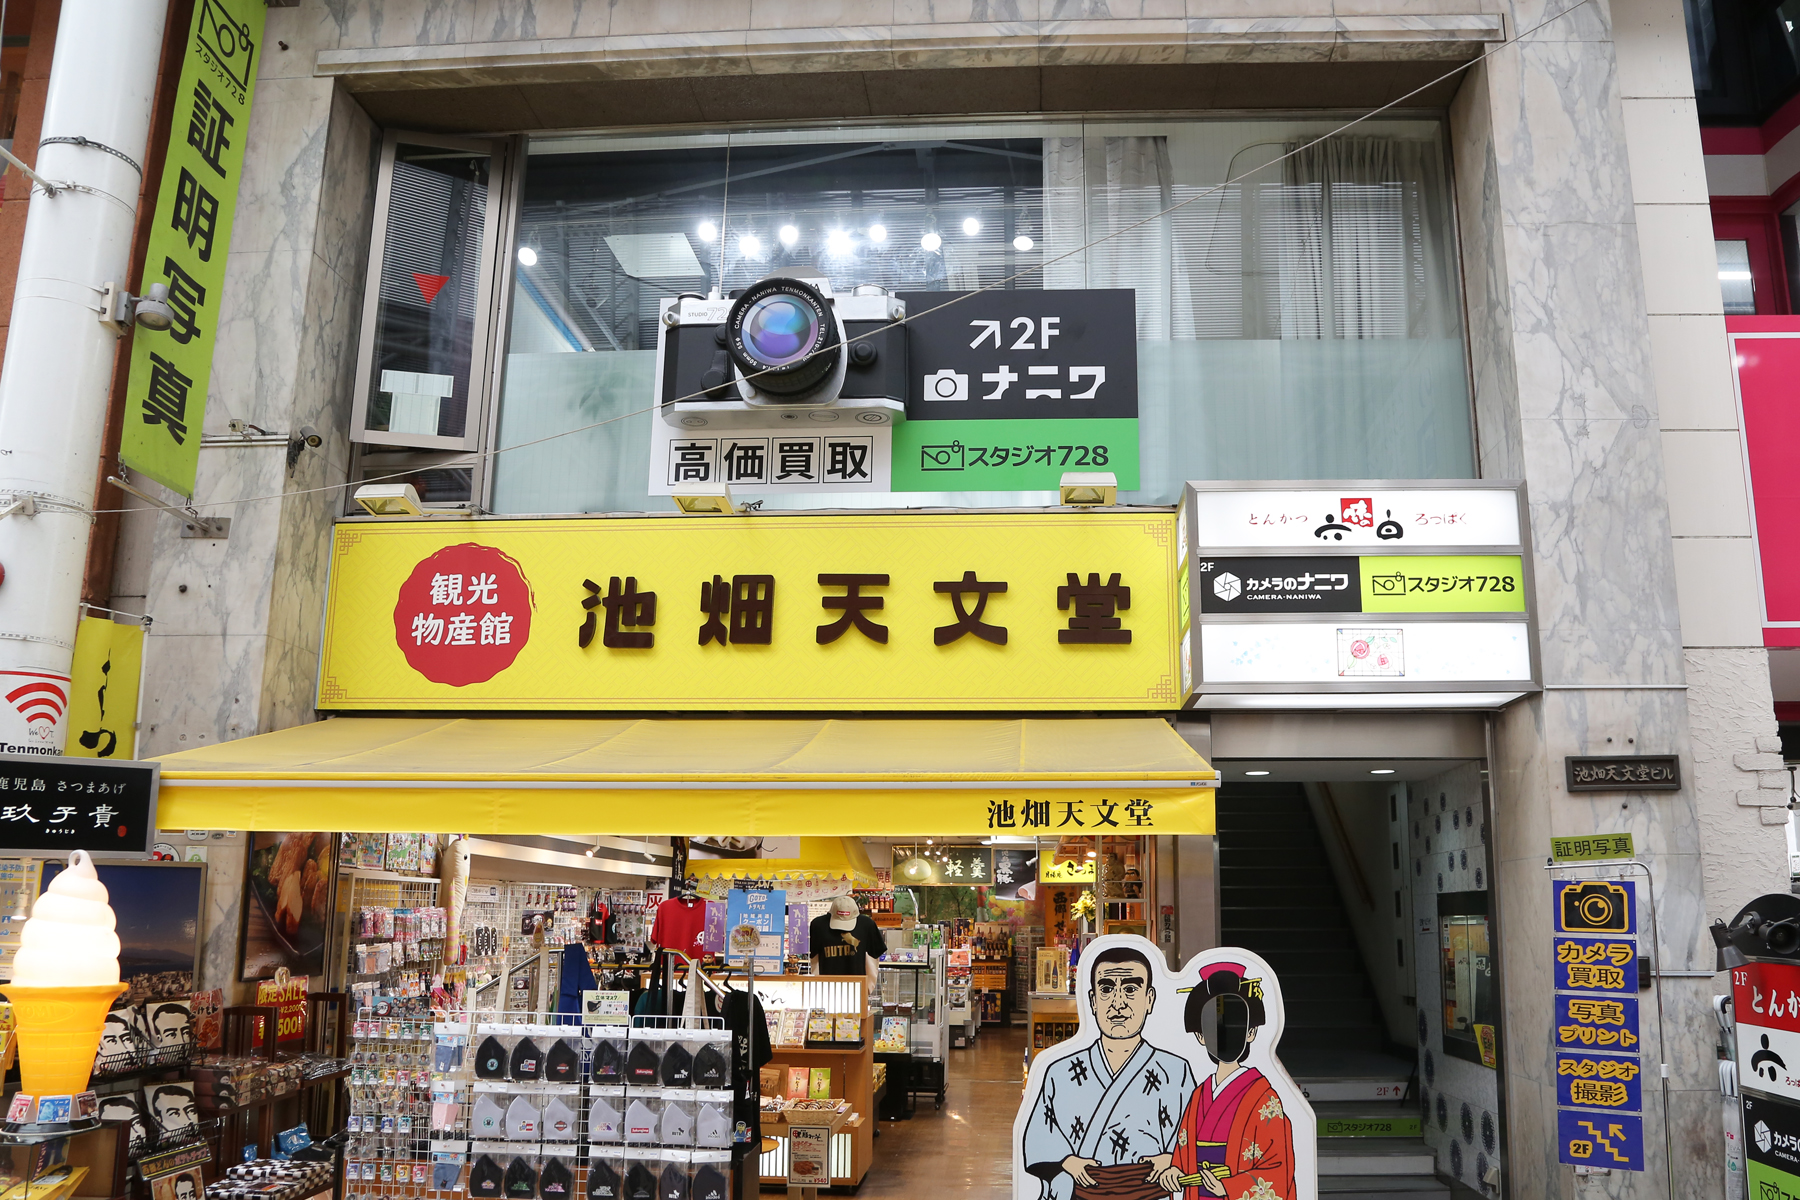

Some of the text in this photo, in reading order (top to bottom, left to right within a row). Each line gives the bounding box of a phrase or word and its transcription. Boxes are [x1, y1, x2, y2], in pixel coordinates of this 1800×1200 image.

[195, 42, 245, 105] スタジオ728
[142, 79, 234, 446] 証明写真
[734, 303, 749, 329] CAMERA
[752, 287, 777, 301] NANIWA
[1010, 316, 1060, 350] 2F
[982, 365, 1106, 400] ナニワ
[673, 441, 870, 483] 高価買取
[968, 444, 1109, 467] スタジオ728
[1248, 513, 1309, 526] とんかつ
[1200, 562, 1215, 573] 2F
[430, 572, 499, 606] 観光
[1246, 572, 1349, 591] カメラのナニワ
[1408, 575, 1515, 593] スタジオ728
[578, 569, 1132, 649] 池畑天文堂
[411, 611, 514, 647] 物産館
[1573, 764, 1675, 783] 池畑天文堂ビル
[57, 780, 127, 795] さつまあげ
[1, 803, 120, 828] 玖子貴
[986, 798, 1155, 829] 池畑天文堂
[1554, 837, 1632, 859] 証明写真
[1557, 941, 1634, 965] カメラ
[1569, 966, 1624, 988] 買取
[1734, 970, 1749, 987] 2F
[279, 979, 306, 1002] SALE
[1570, 1001, 1625, 1024] 写真
[1559, 1026, 1637, 1047] プリント
[1559, 1060, 1639, 1080] スタジオ
[1376, 1086, 1390, 1096] 2F
[1571, 1081, 1628, 1106] 撮影
[1745, 1100, 1753, 1110] 2F
[1344, 1123, 1392, 1132] スタジオ728
[1570, 1141, 1592, 1157] 2F
